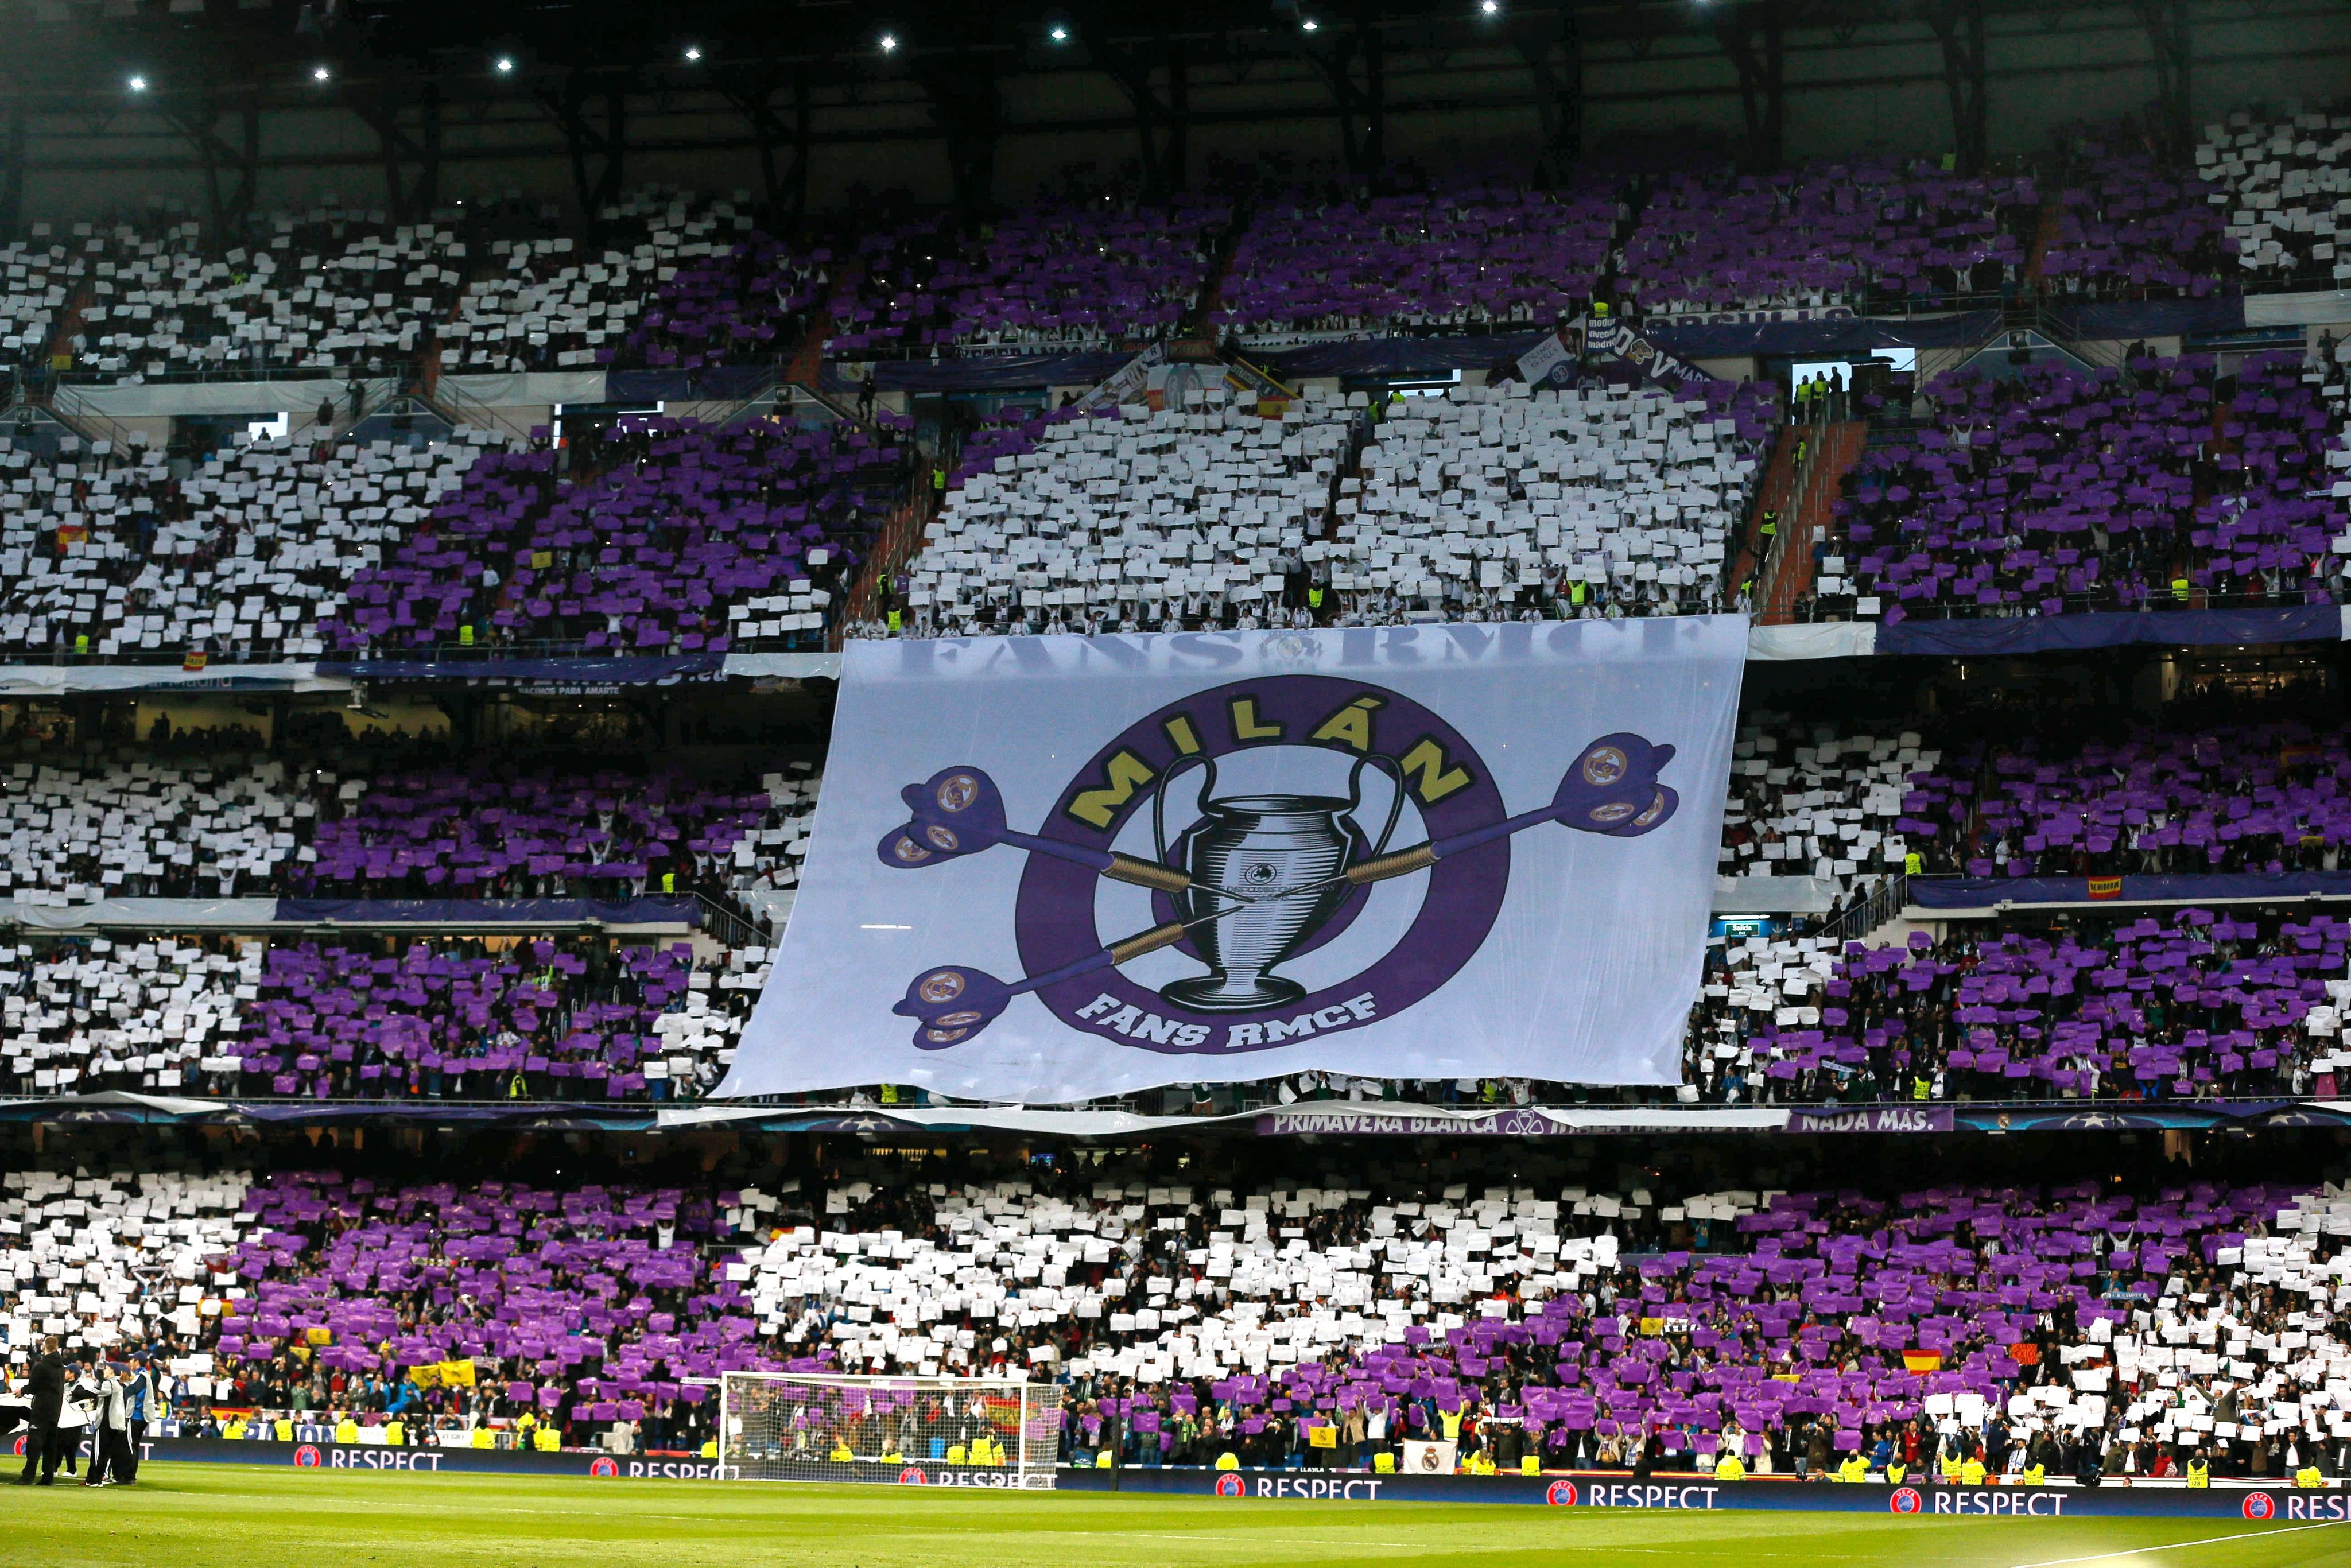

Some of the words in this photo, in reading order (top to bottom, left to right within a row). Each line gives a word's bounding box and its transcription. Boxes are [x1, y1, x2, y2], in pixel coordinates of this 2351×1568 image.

[1588, 327, 1616, 338] vivendi
[1589, 318, 1616, 327] modus
[1650, 350, 1677, 378] V
[558, 686, 581, 694] PARA
[585, 686, 619, 694] AMARTE
[1069, 697, 1471, 829] MILÁN
[1075, 993, 1211, 1047] FANS
[1225, 992, 1377, 1048] RMCF
[1274, 1115, 1404, 1133] PRIMAVERA
[1411, 1114, 1498, 1133] BLANCA
[1802, 1109, 1869, 1131] NADA
[1877, 1108, 1935, 1131] MÁS.
[331, 1449, 444, 1471] RESPECT
[1257, 1478, 1382, 1500] RESPECT
[1553, 1482, 1572, 1491] UEFA
[1590, 1484, 1719, 1509] RESPECT
[2248, 1494, 2268, 1503] UEFA
[1895, 1489, 1915, 1498] UEFA
[1935, 1492, 2067, 1516] RESPECT
